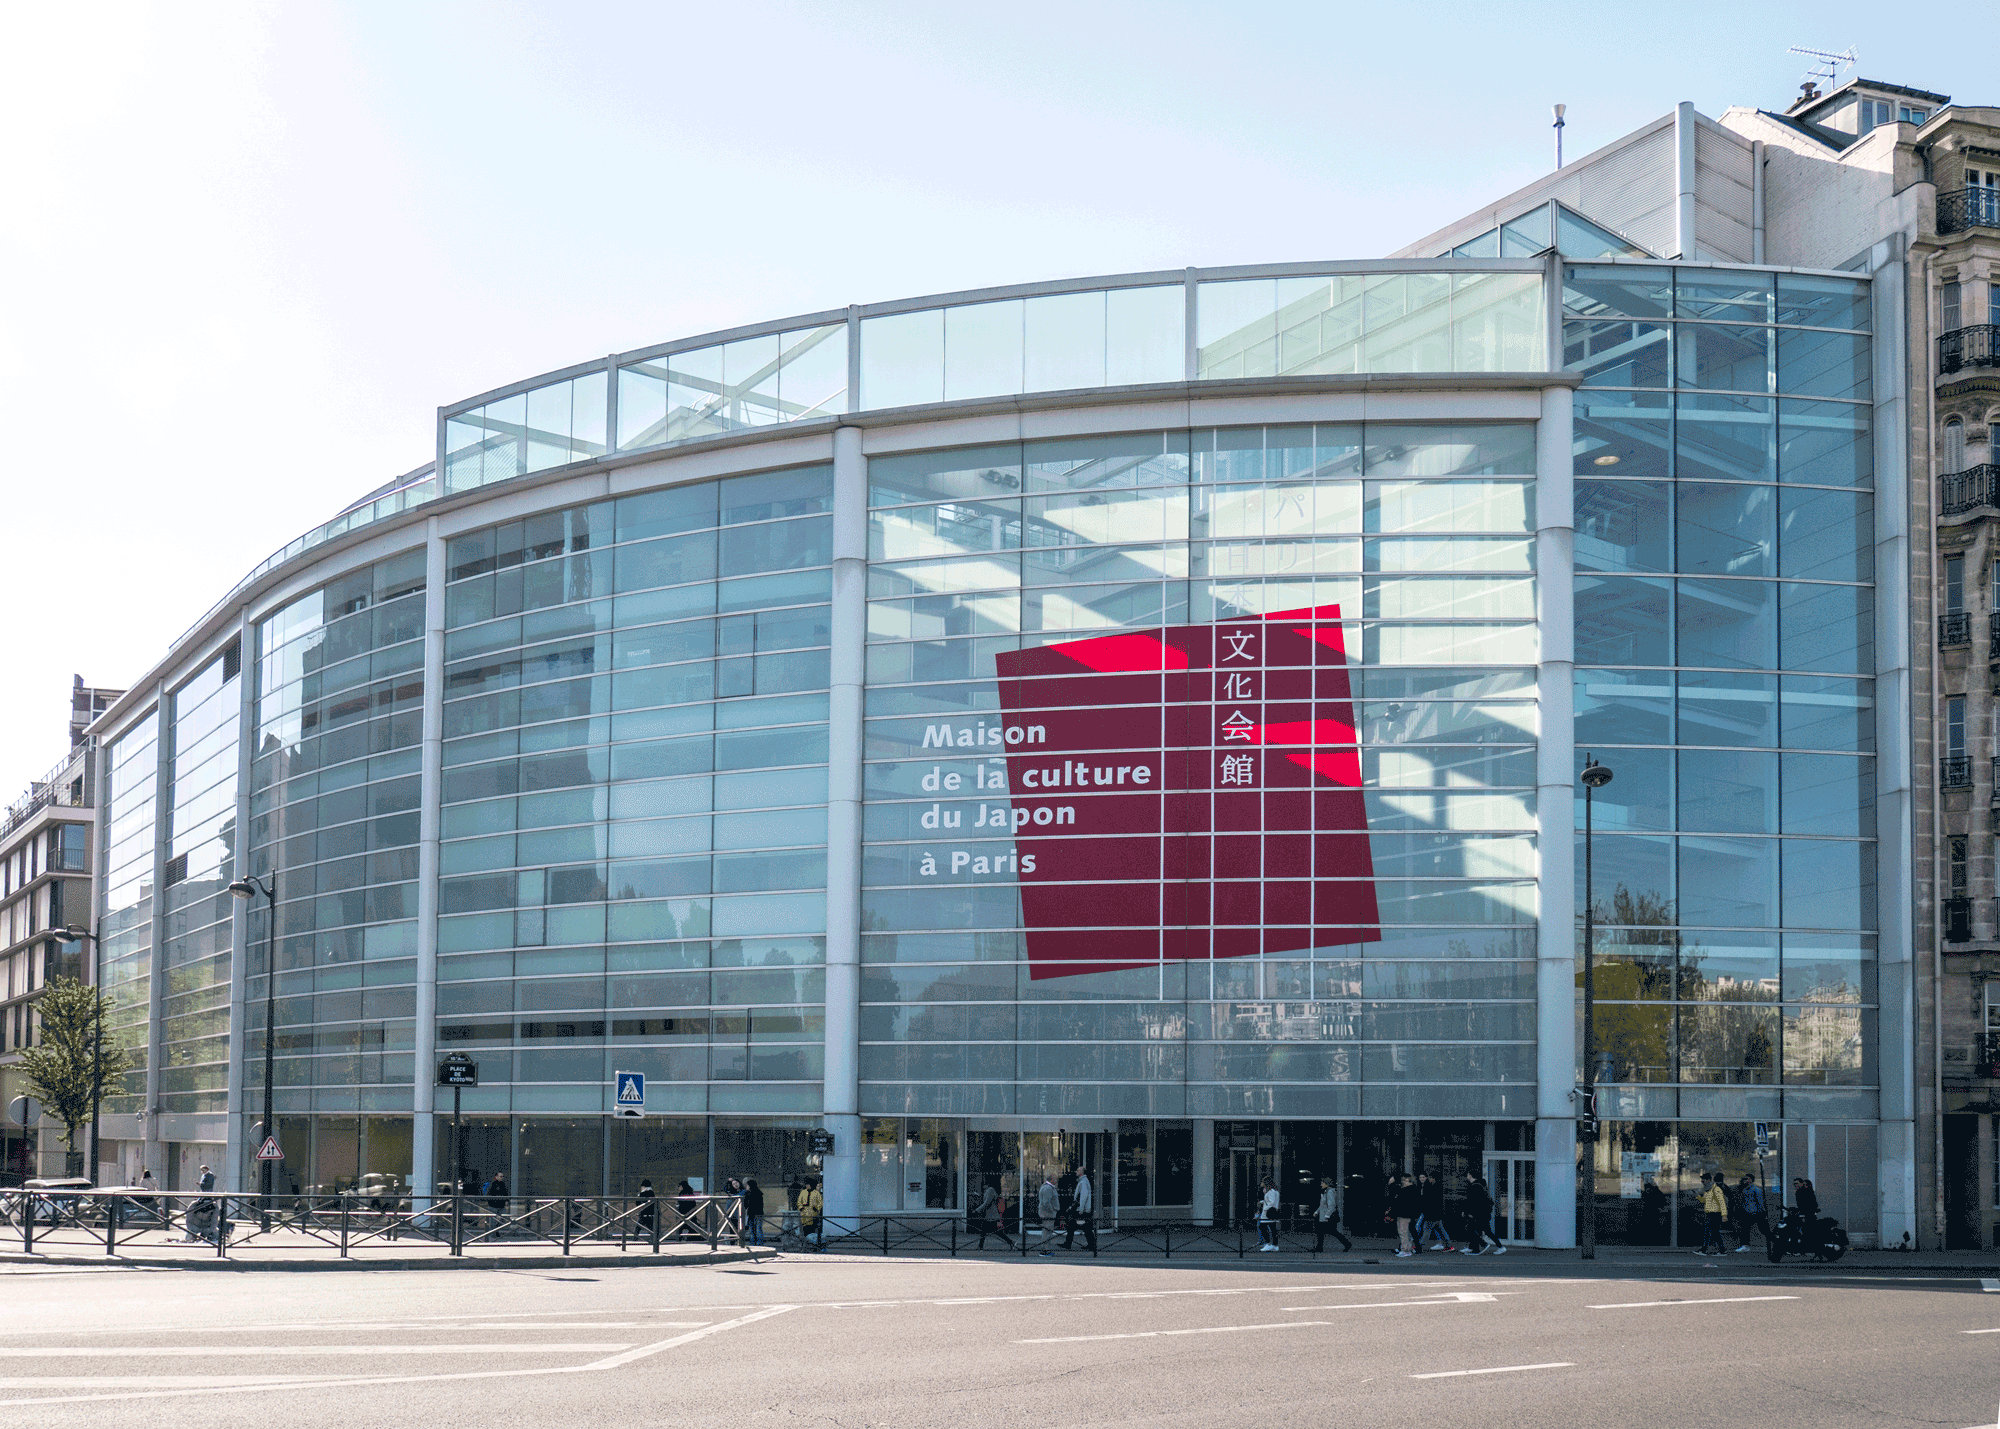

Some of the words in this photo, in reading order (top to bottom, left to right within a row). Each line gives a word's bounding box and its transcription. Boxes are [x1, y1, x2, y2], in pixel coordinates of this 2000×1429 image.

[1220, 541, 1255, 786] 日本文化会館
[922, 722, 1046, 748] Maison
[921, 766, 961, 791] de
[977, 764, 1005, 789] la
[1022, 760, 1151, 787] culture
[921, 804, 961, 829] du
[974, 804, 1075, 833] Japon
[920, 851, 937, 876] à
[951, 848, 1036, 875] Paris
